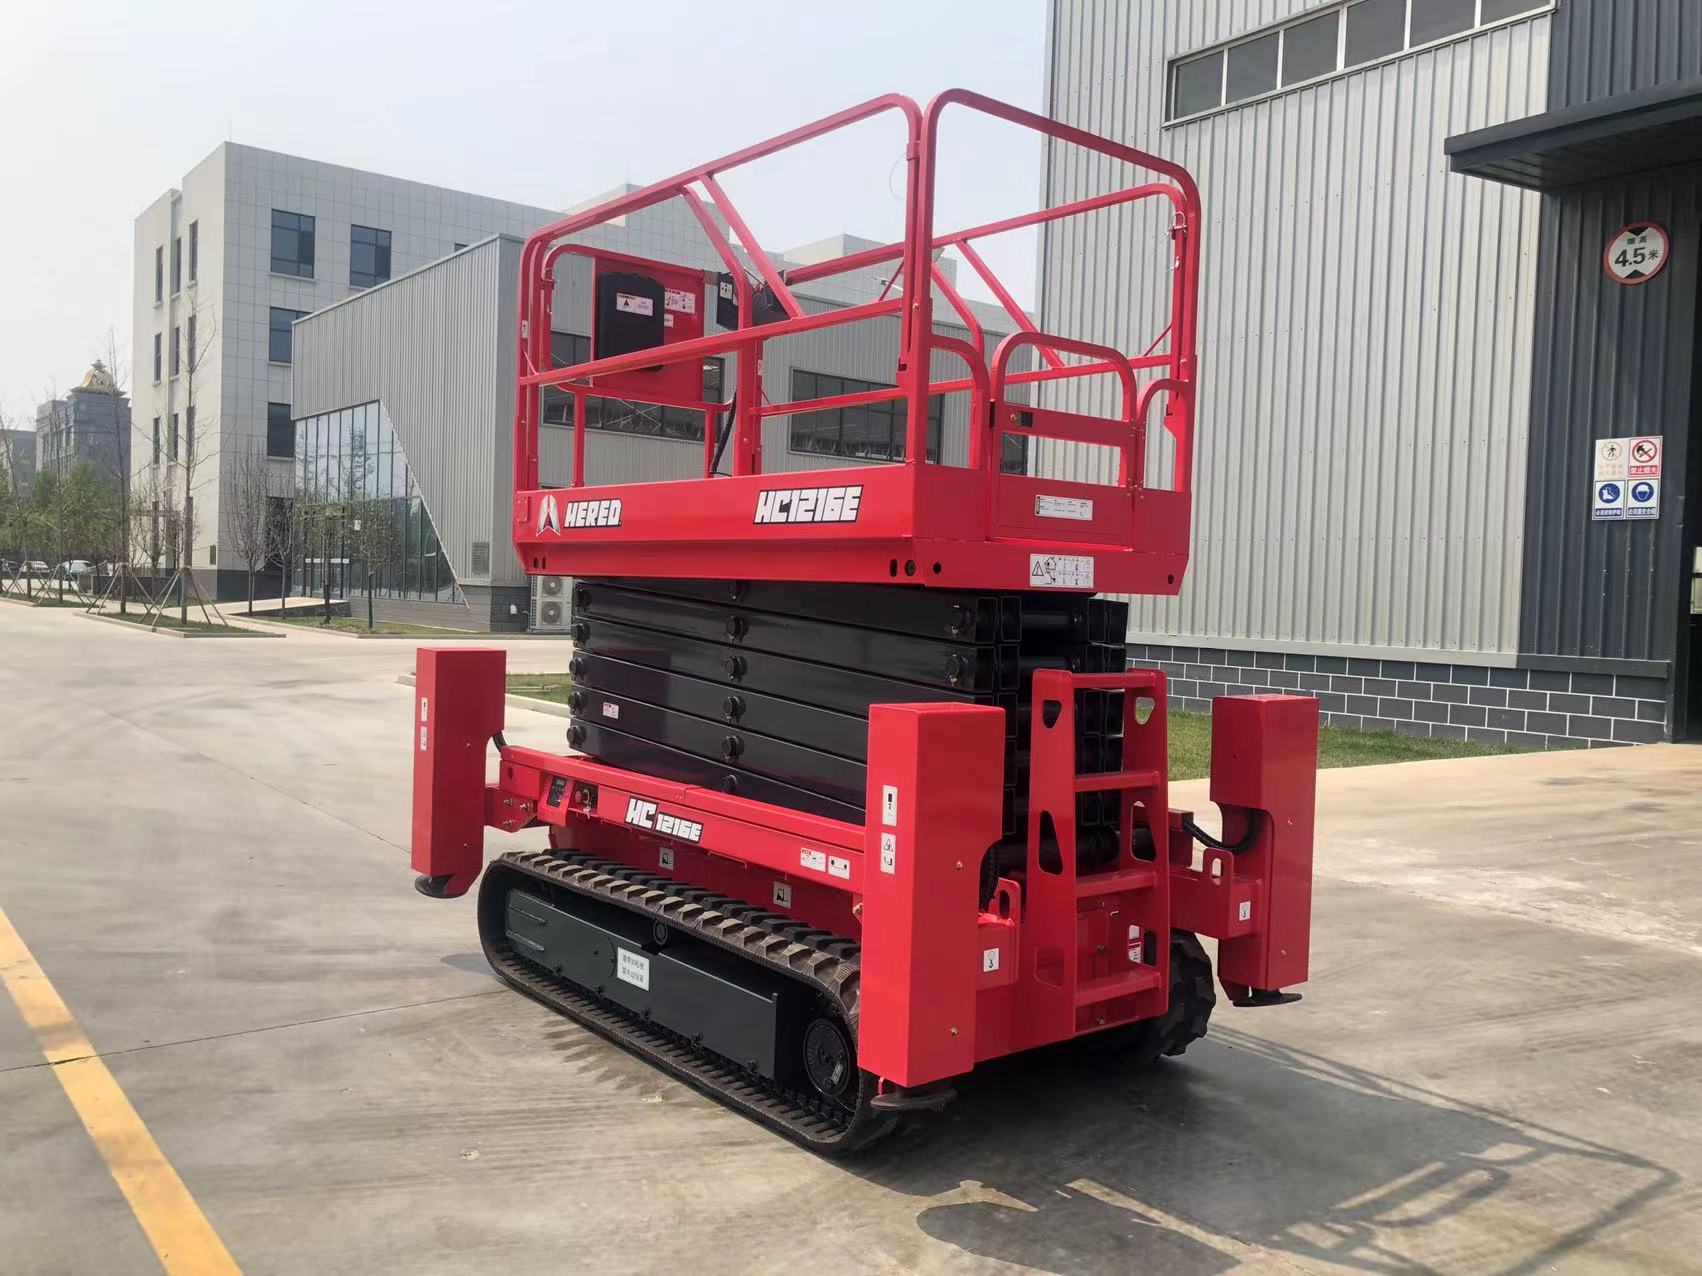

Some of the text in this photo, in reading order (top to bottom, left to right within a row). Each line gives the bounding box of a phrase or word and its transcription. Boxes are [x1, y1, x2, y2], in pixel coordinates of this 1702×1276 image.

[753, 486, 863, 523] HC1216E
[625, 798, 703, 842] HC 1216E
